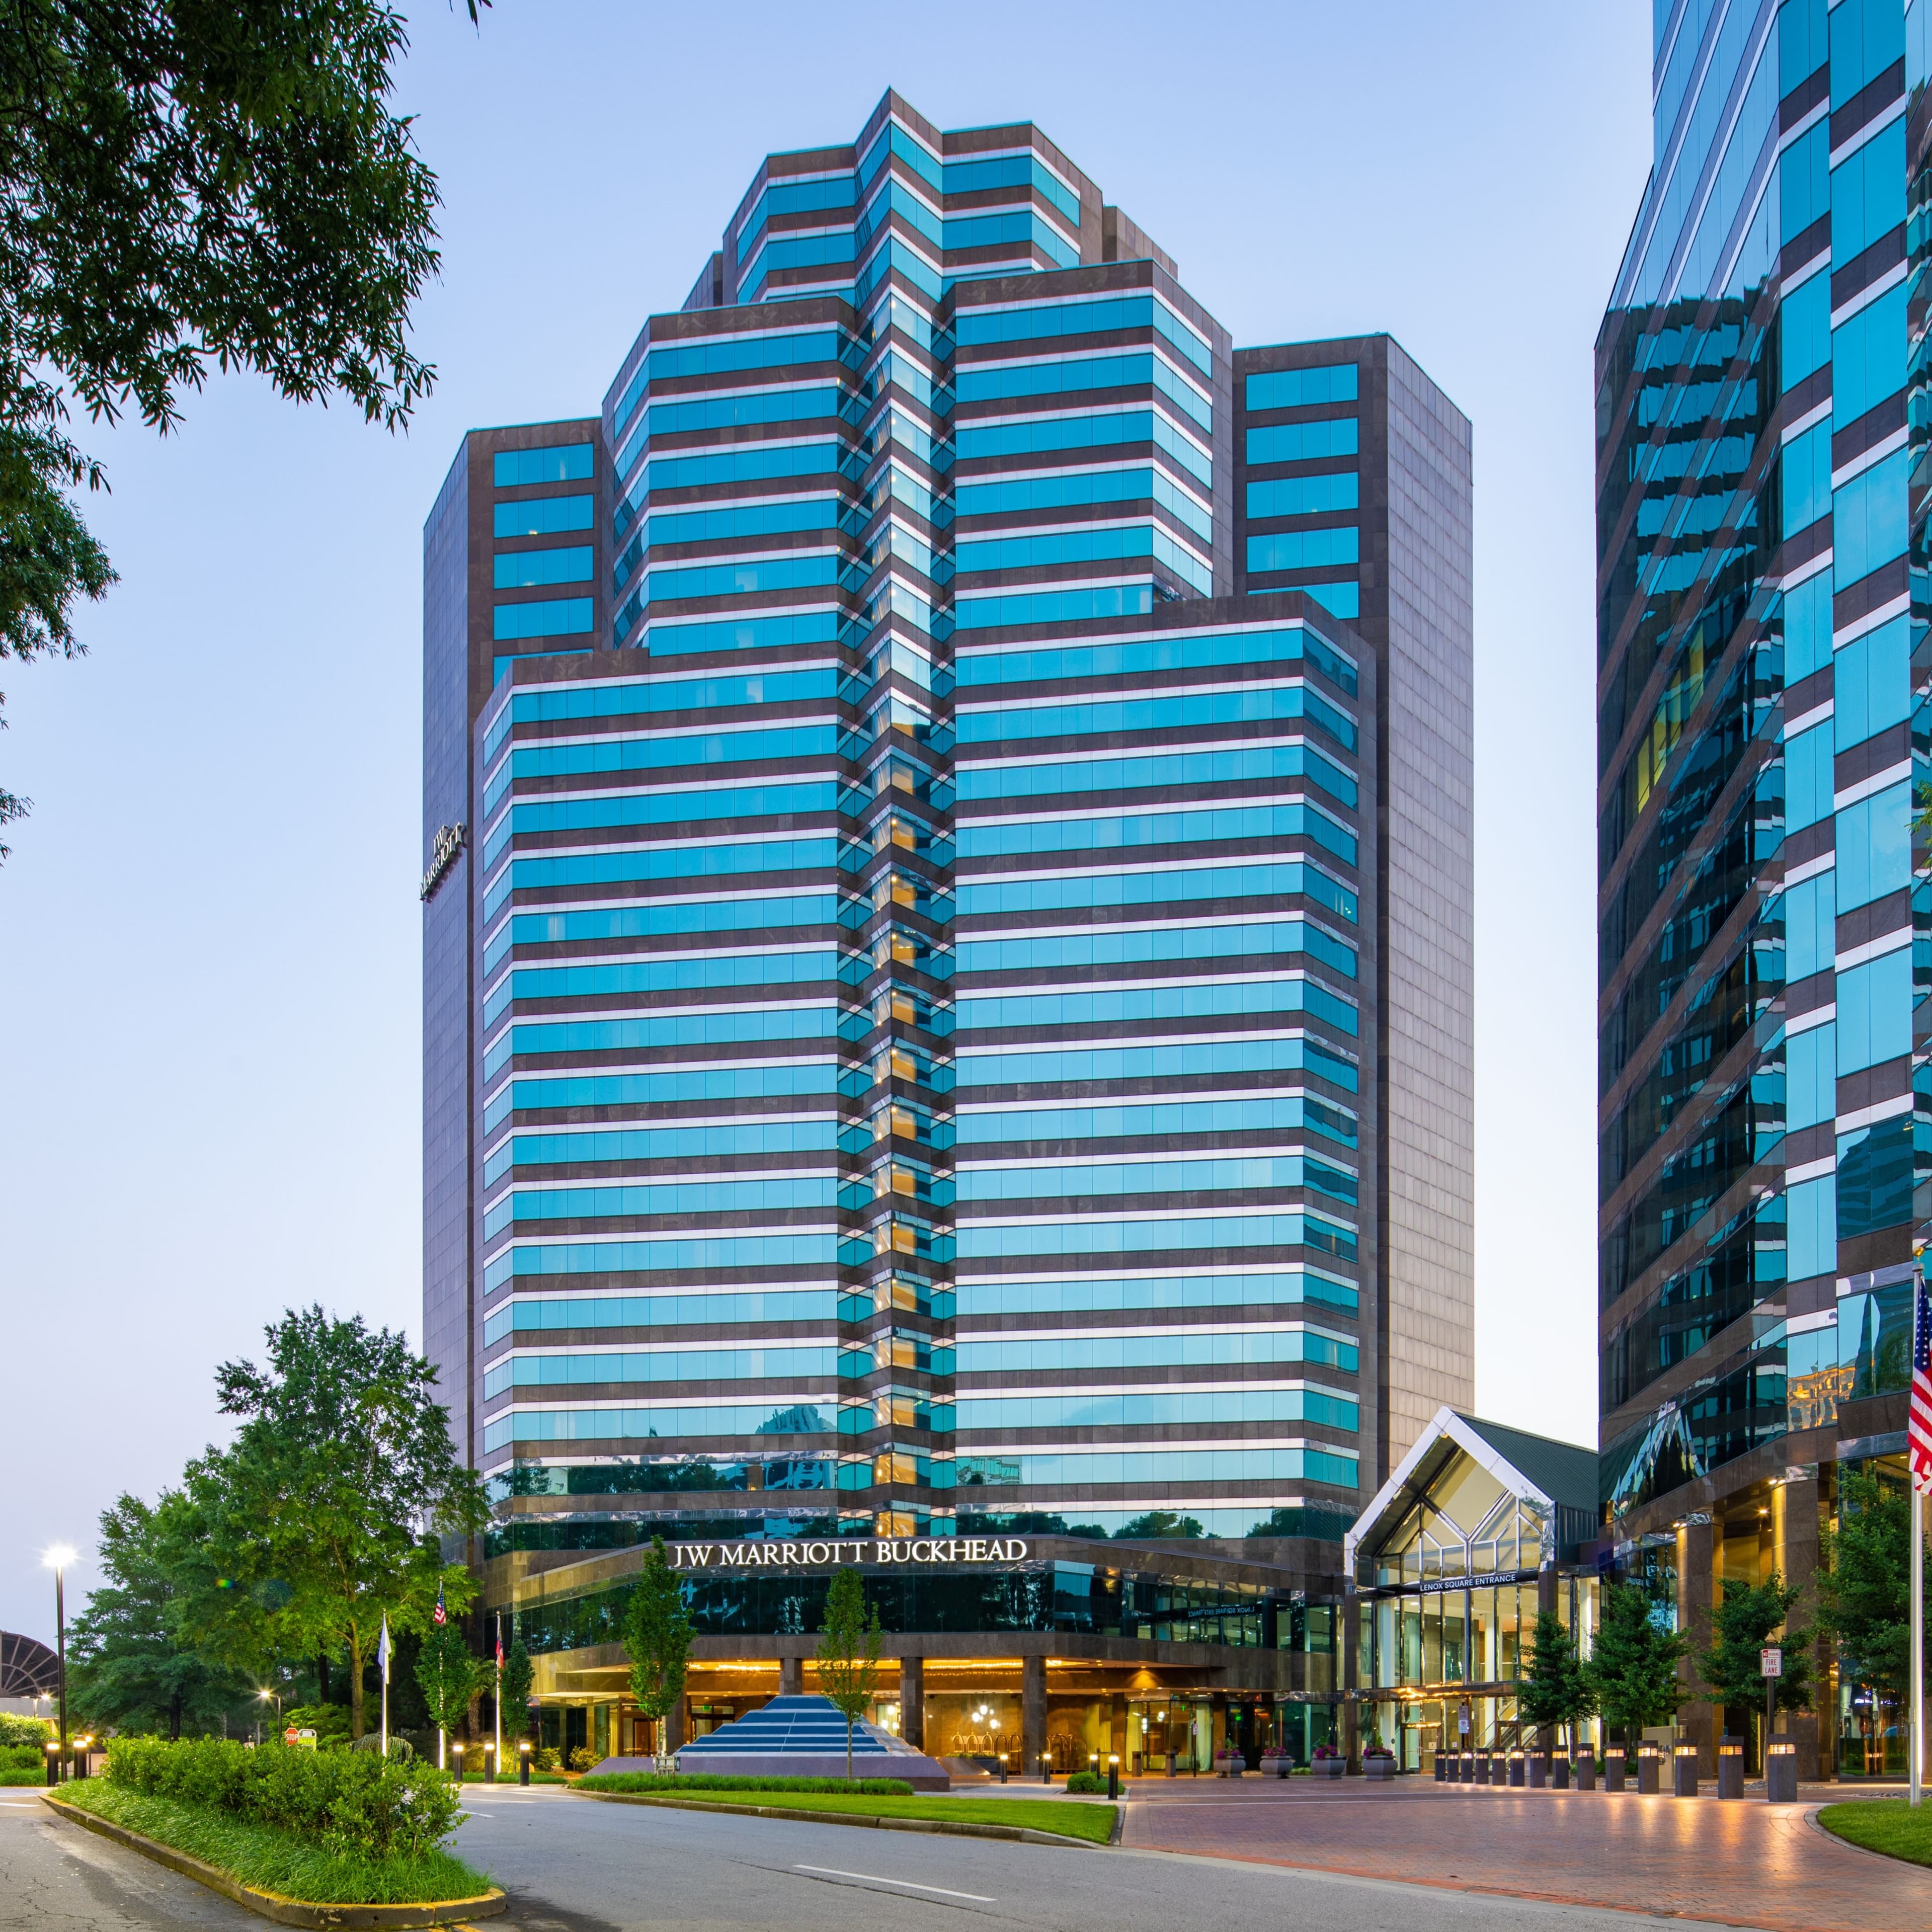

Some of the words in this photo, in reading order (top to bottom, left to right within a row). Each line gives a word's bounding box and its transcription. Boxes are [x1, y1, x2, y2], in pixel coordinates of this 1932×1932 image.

[419, 821, 463, 901] MARRIOTT
[674, 1545, 713, 1568] JW
[718, 1541, 868, 1565] MARRIOTT
[876, 1539, 1027, 1563] BUCKHEAD
[1420, 1582, 1443, 1591] LENOX
[1444, 1579, 1474, 1589] SQUARE
[1475, 1574, 1516, 1585] ENTRANCE
